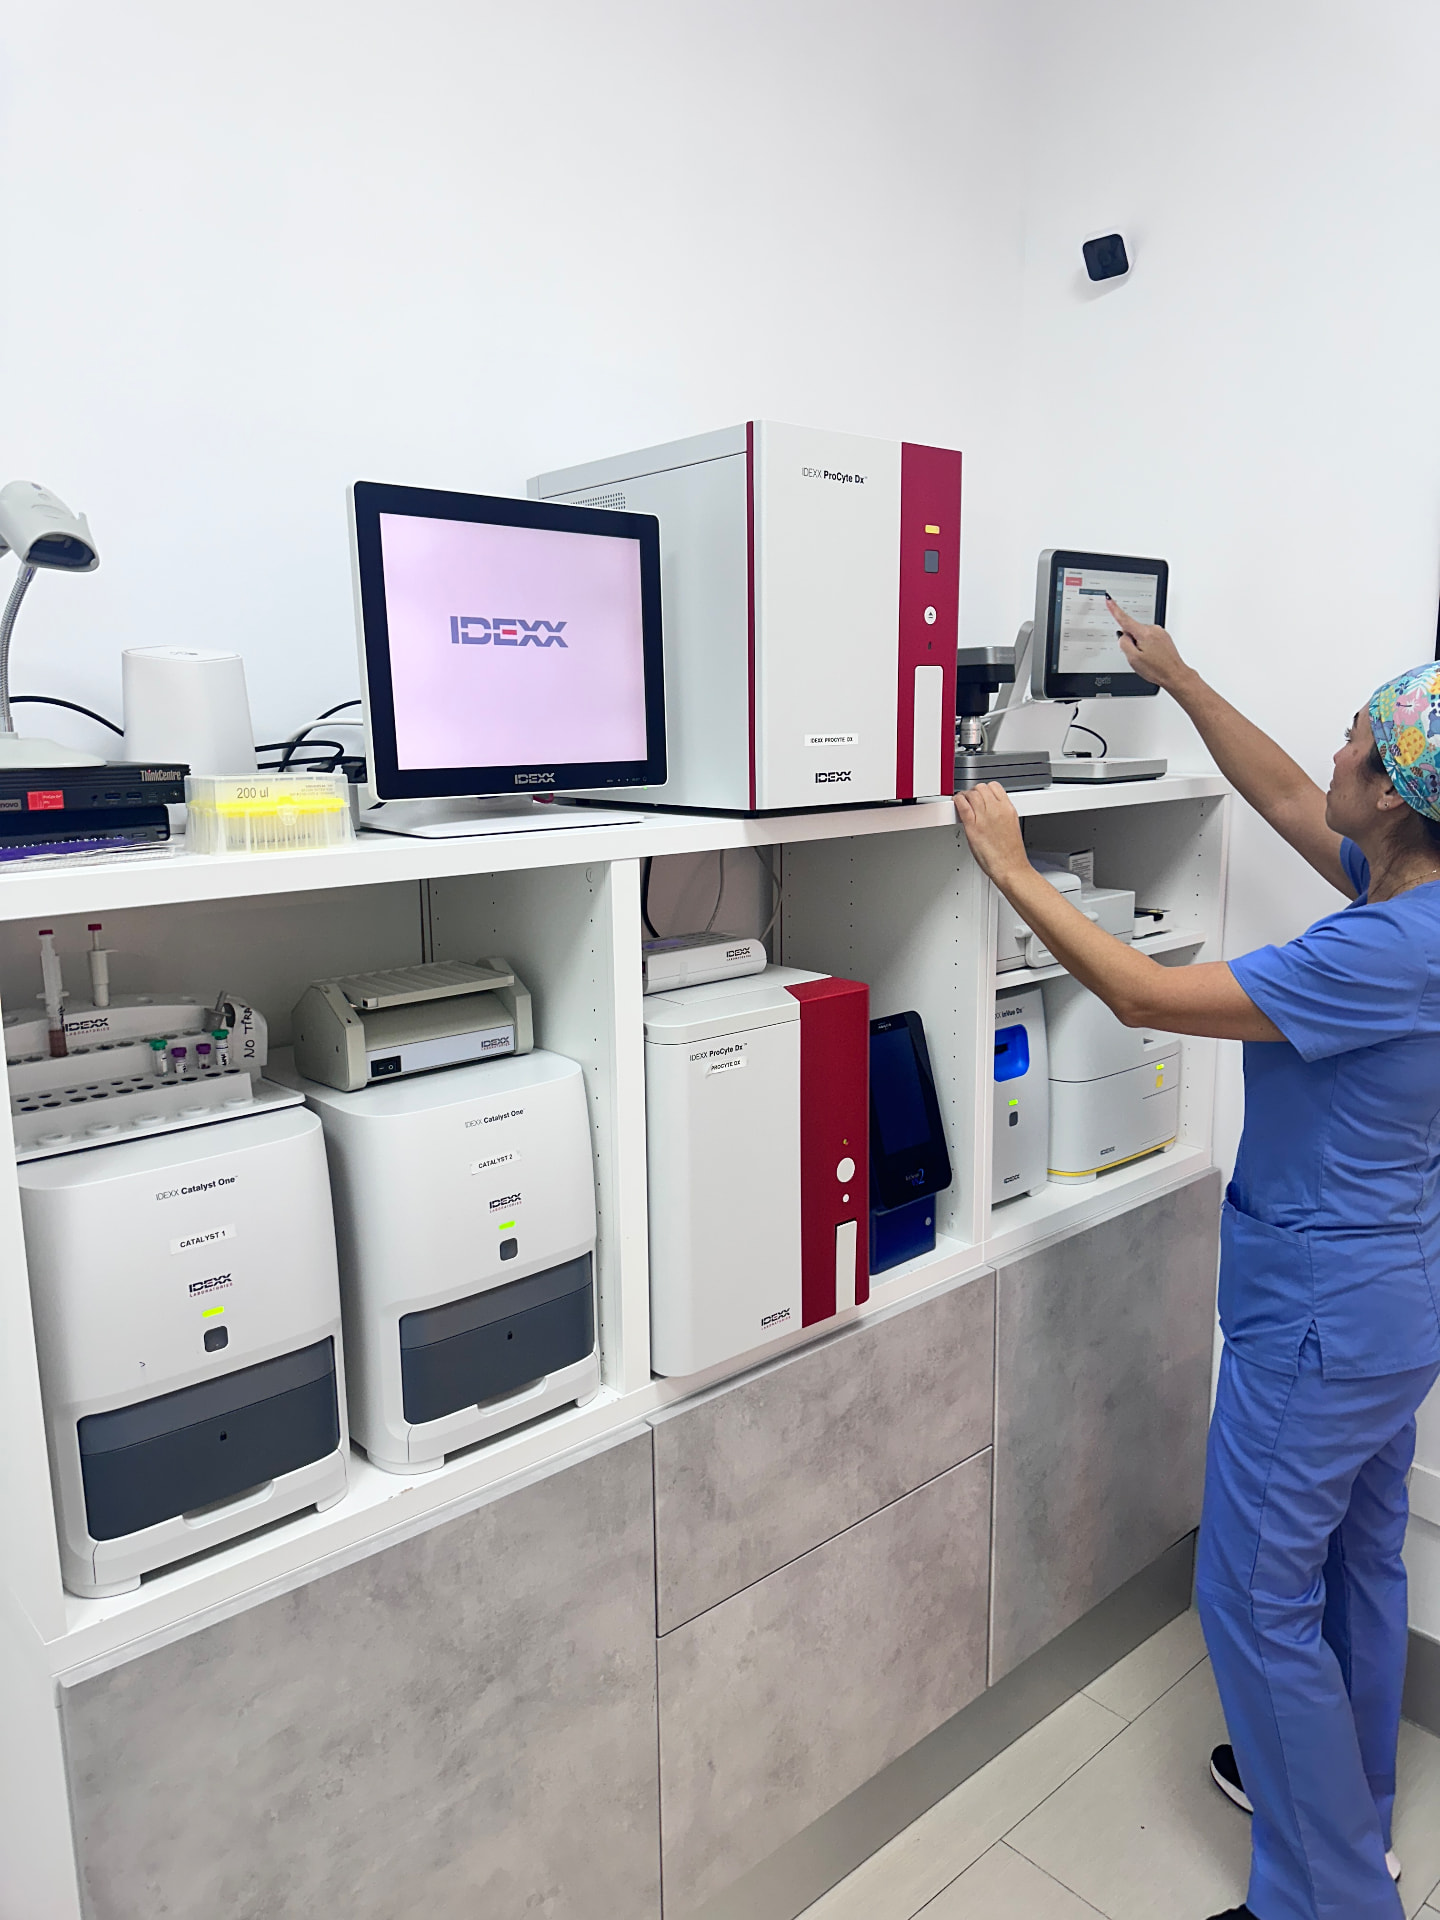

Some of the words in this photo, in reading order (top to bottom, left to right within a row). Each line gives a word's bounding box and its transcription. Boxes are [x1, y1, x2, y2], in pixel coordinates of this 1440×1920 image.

[802, 467, 822, 478] IDEXX
[823, 470, 853, 484] ProCyte
[854, 474, 865, 484] Dx
[449, 615, 569, 648] IDEXX
[140, 769, 182, 782] ThinkCentre
[514, 772, 555, 785] IDEXX
[815, 770, 852, 783] IDEXX
[236, 787, 256, 799] 200
[259, 787, 269, 798] ul
[726, 947, 751, 958] IDEXX
[65, 1017, 109, 1032] IDEXX
[244, 1039, 255, 1058] NO
[481, 1036, 509, 1048] IDEXX
[689, 1051, 708, 1062] IDEXX
[709, 1045, 734, 1058] ProCyte
[735, 1043, 743, 1051] Dx
[465, 1119, 483, 1128] IDEXX
[483, 1112, 510, 1124] Catalyst
[510, 1109, 524, 1117] One
[478, 1155, 508, 1169] CATALYST
[155, 1189, 180, 1201] IDEXX
[181, 1180, 217, 1195] Catalyst
[218, 1177, 236, 1186] One
[489, 1192, 522, 1209] IDEXX
[180, 1231, 220, 1248] CATALYST
[188, 1273, 232, 1293] IDEXX
[189, 1282, 233, 1298] LABORATORIES
[761, 1307, 790, 1326] IDEXX
